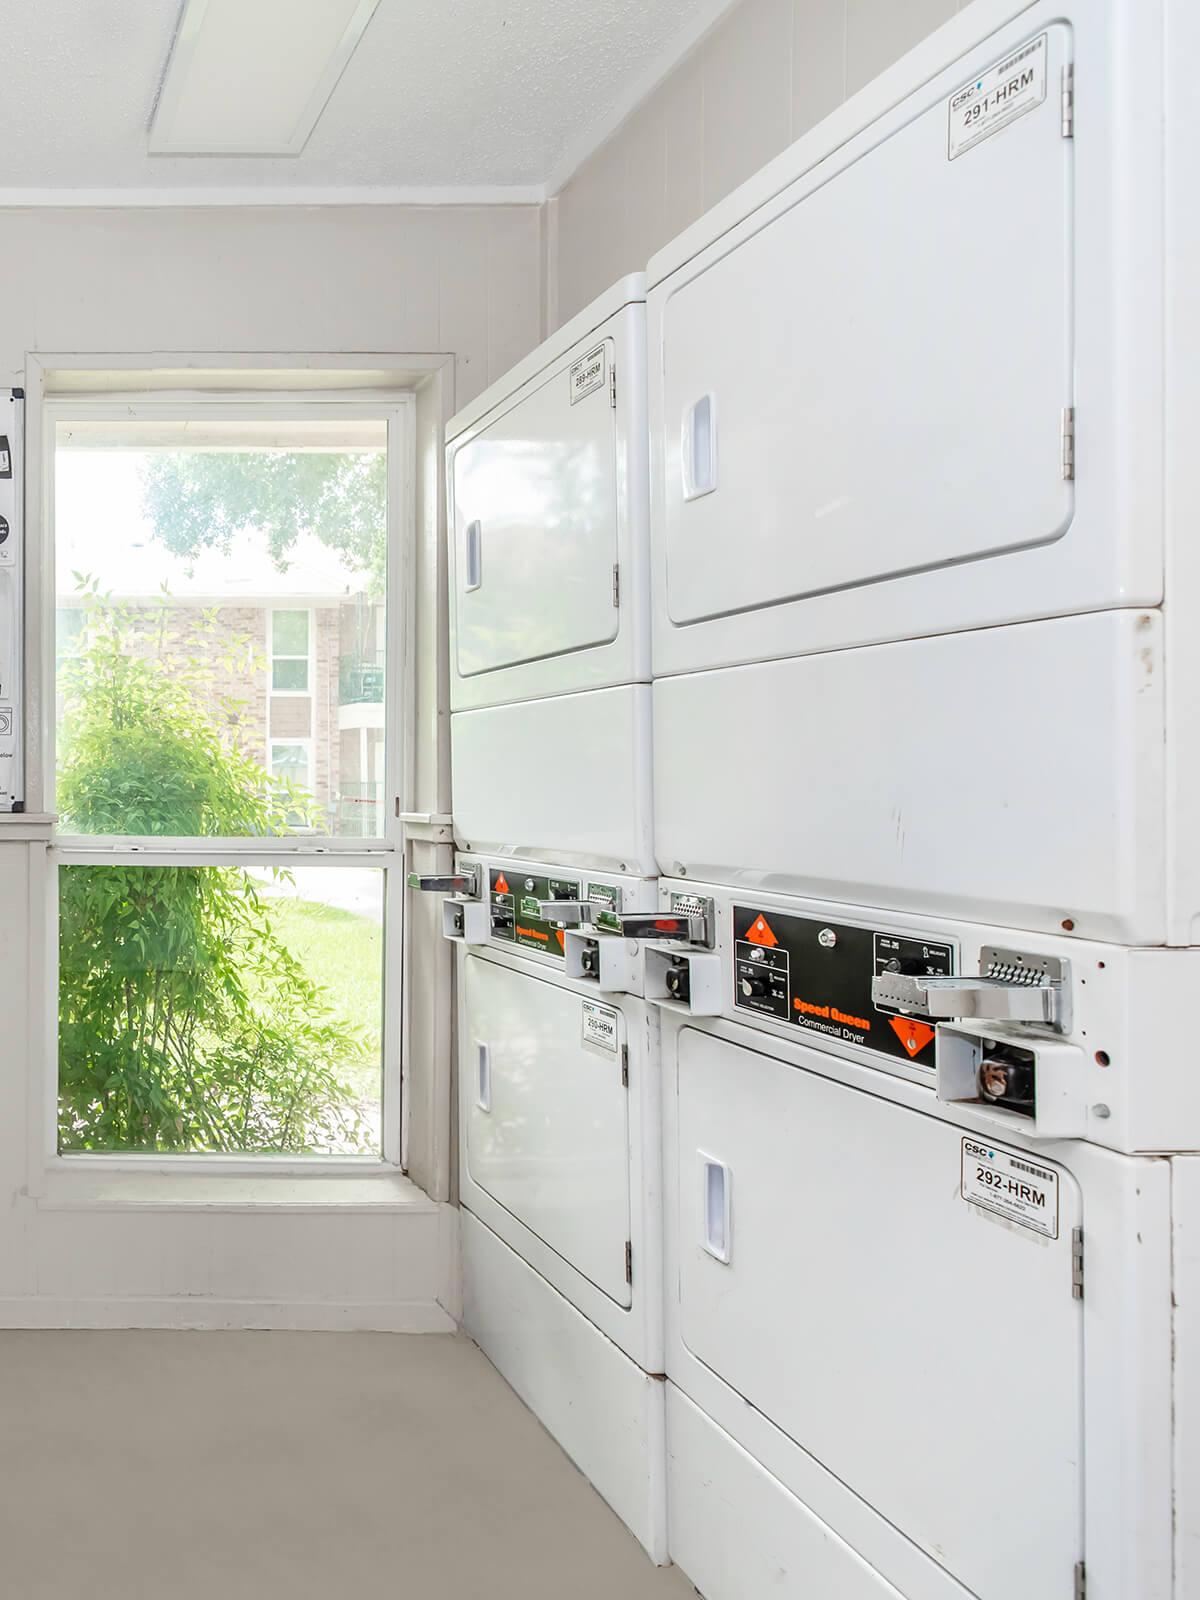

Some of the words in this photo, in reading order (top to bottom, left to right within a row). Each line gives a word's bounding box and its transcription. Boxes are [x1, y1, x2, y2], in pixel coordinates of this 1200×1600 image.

[952, 86, 975, 108] CSC
[964, 67, 1034, 126] 291-HRM
[794, 997, 829, 1018] Speed
[830, 1008, 870, 1031] Queen
[798, 1015, 841, 1036] Commercial
[842, 1028, 865, 1044] Dryer
[965, 1142, 987, 1156] CSC
[976, 1167, 1045, 1208] 292-HRM
